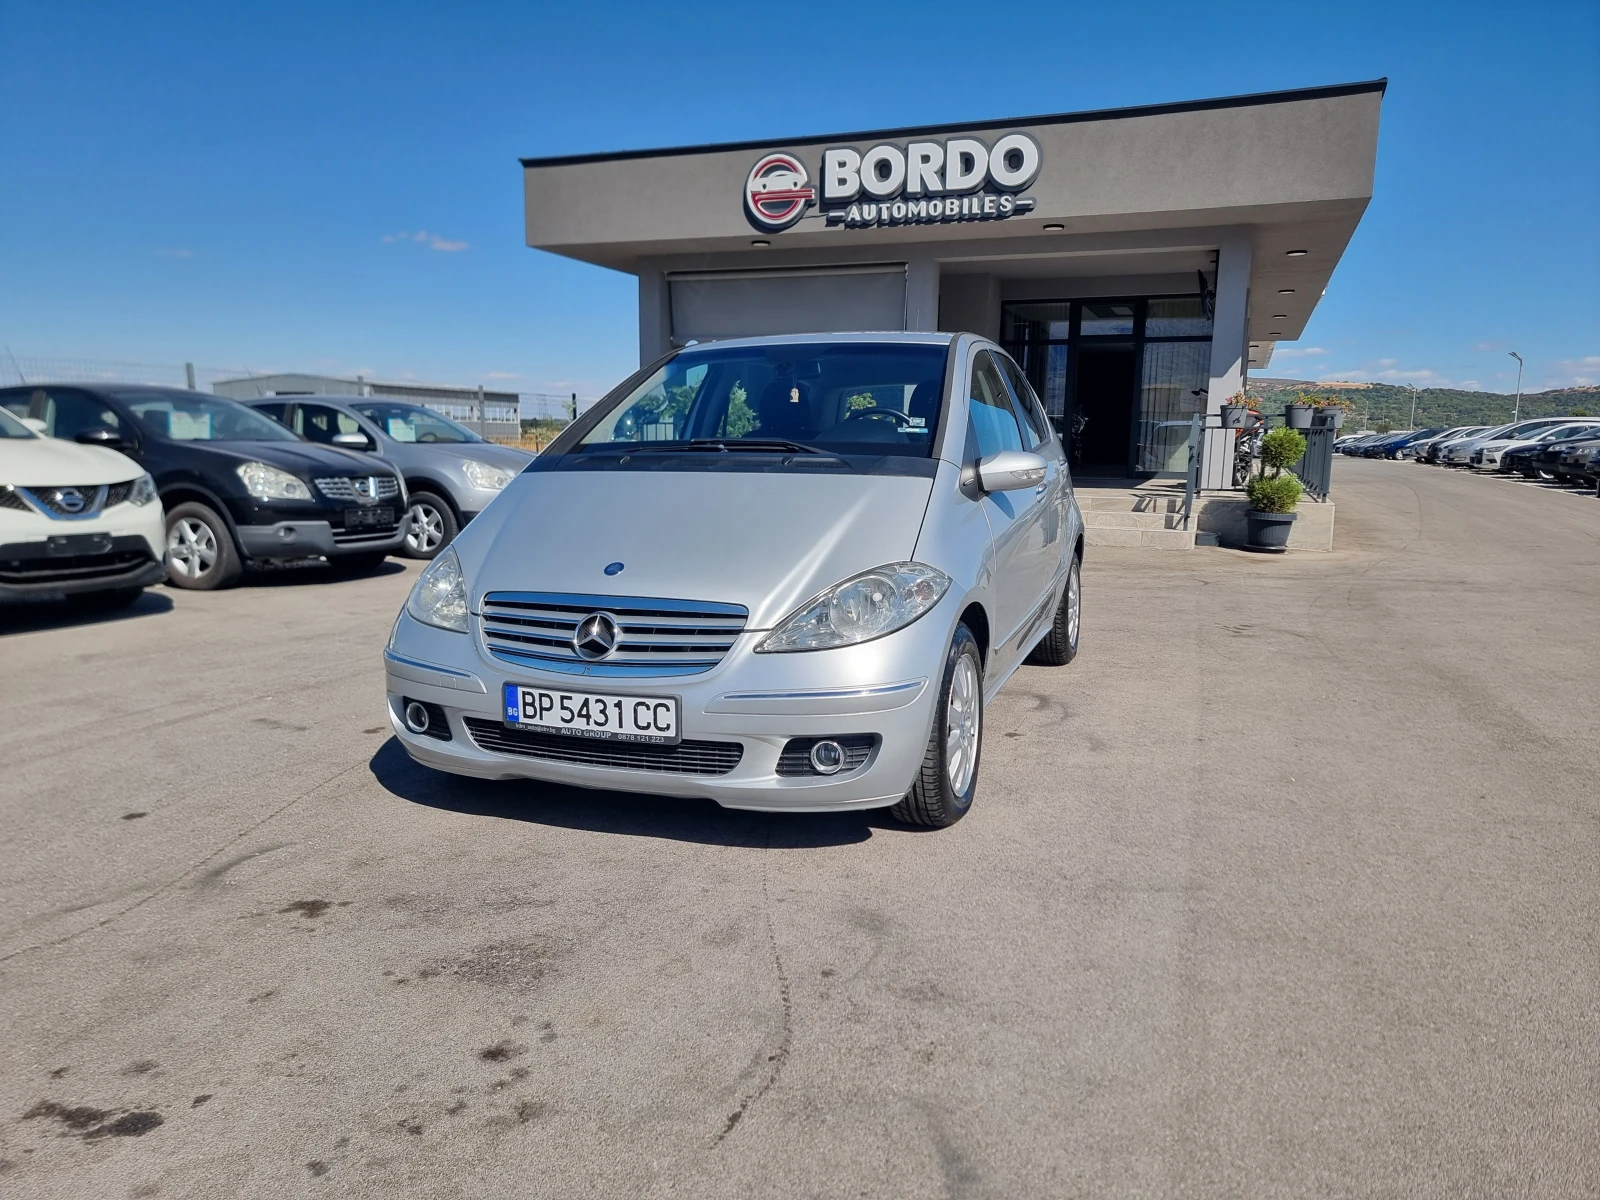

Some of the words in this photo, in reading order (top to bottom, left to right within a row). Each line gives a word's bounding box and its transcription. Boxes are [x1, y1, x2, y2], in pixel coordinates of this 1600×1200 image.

[824, 135, 1039, 198] BORDO
[846, 195, 1013, 222] AUTOMOBILES
[507, 706, 518, 717] BG
[560, 727, 582, 736] AUTO
[583, 730, 612, 739] GROUP
